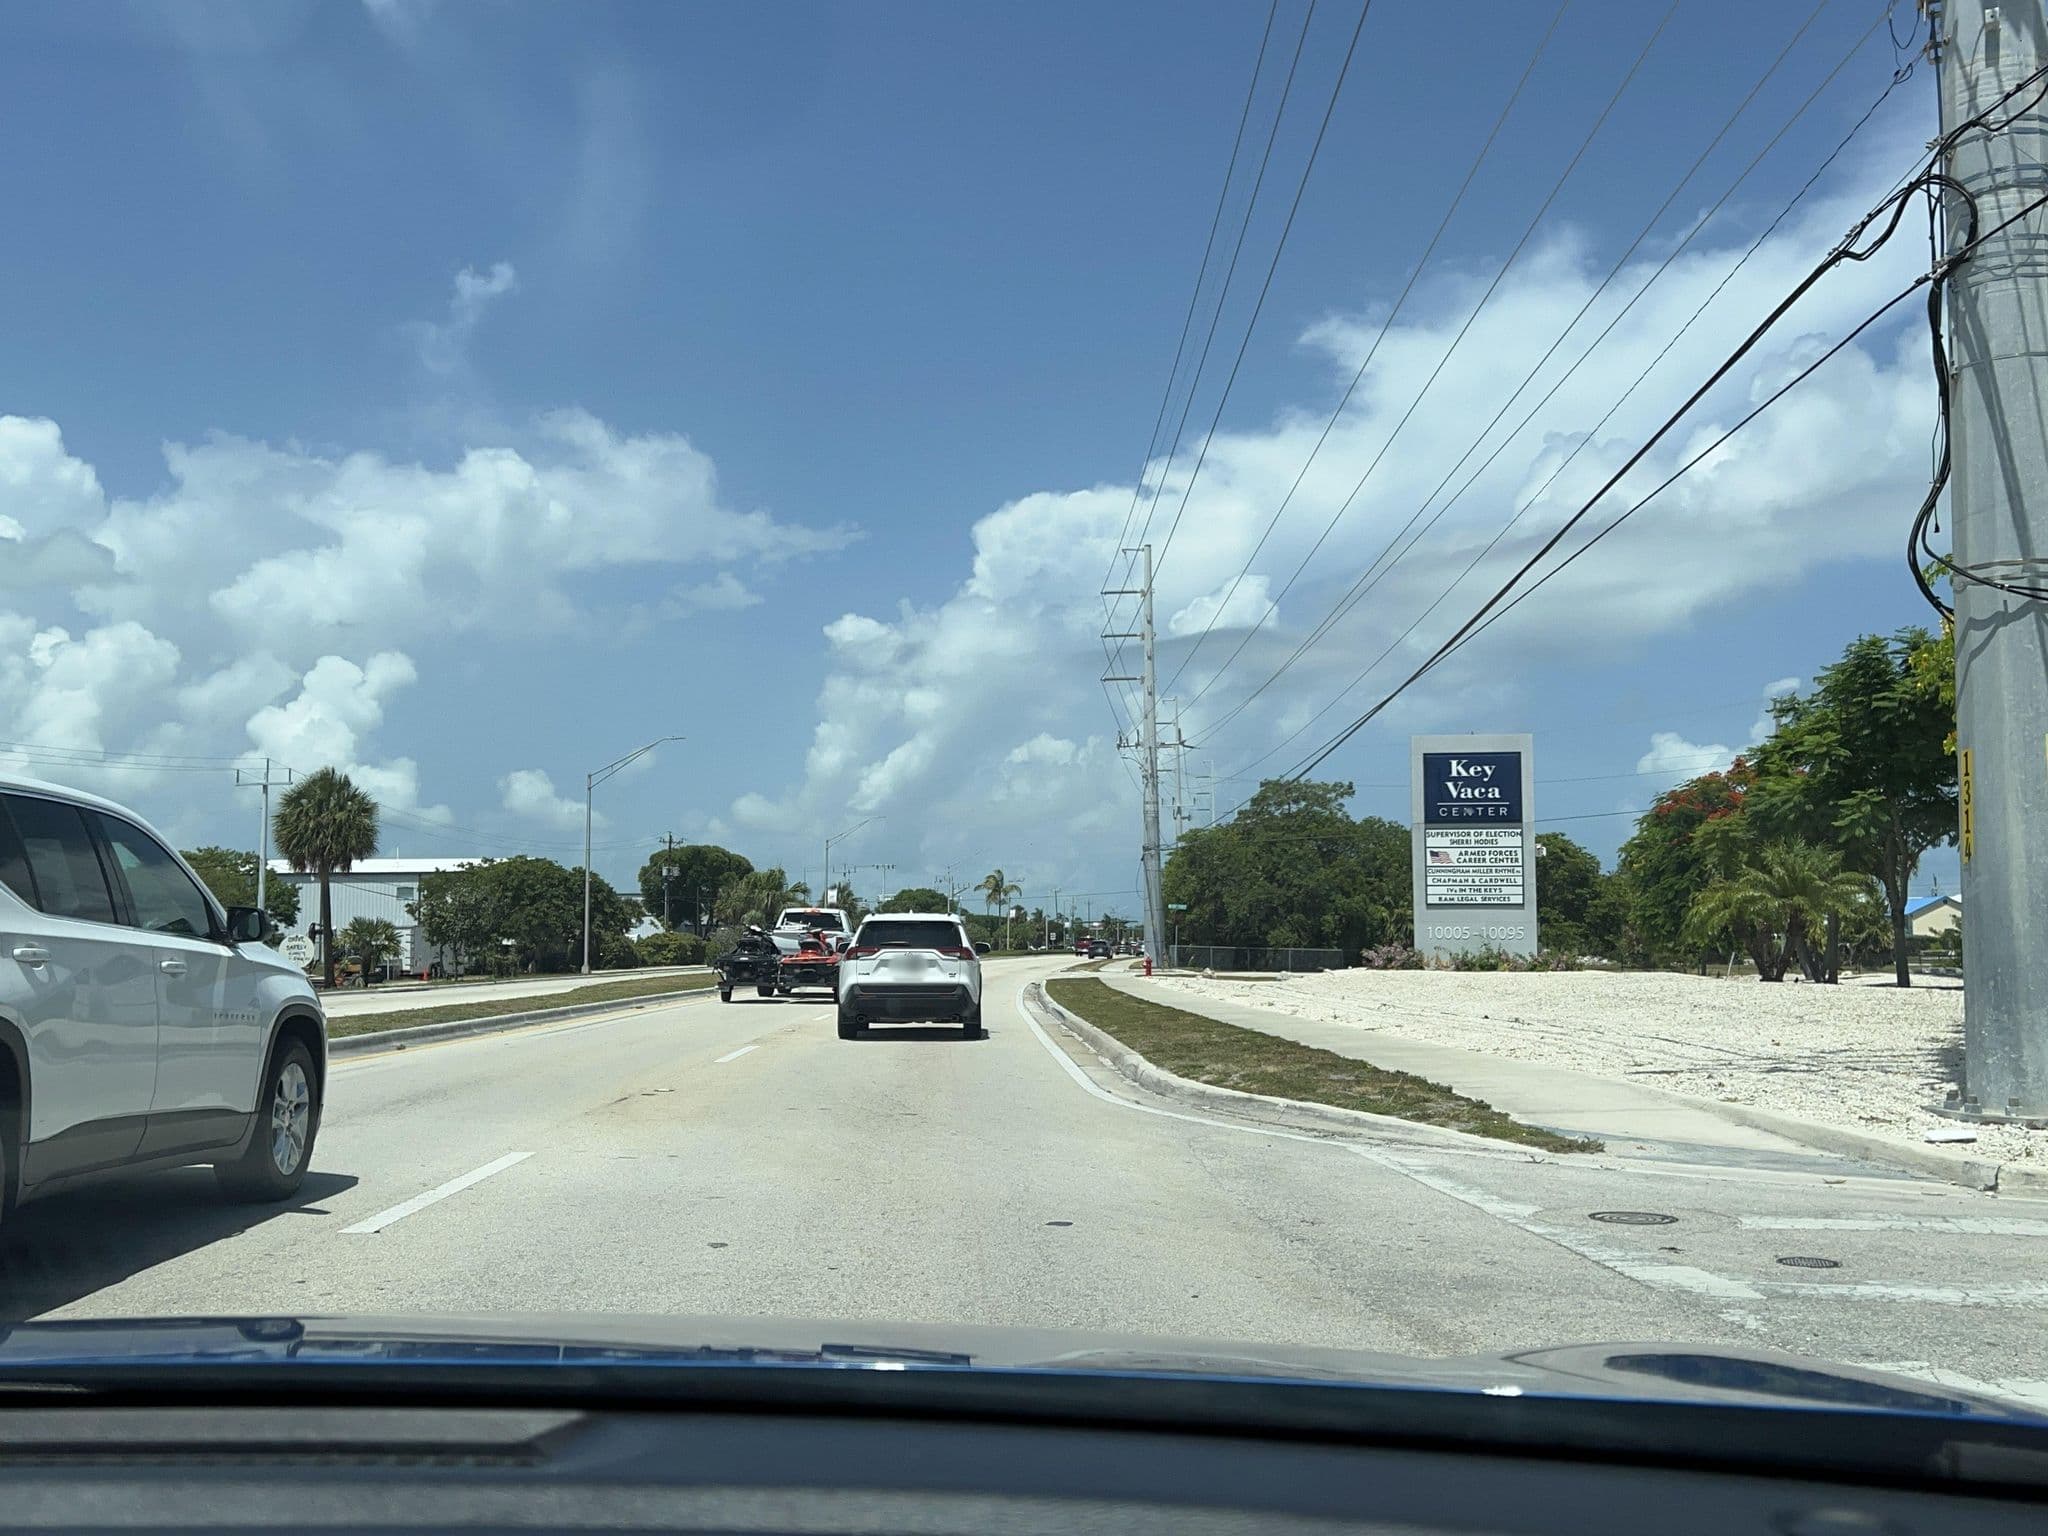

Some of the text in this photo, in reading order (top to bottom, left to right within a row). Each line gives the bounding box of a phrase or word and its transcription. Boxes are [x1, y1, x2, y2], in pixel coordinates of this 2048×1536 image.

[1449, 759, 1496, 782] Key
[1445, 781, 1501, 799] Vaca
[1439, 807, 1508, 817] CENTER
[1964, 751, 1972, 862] 1314
